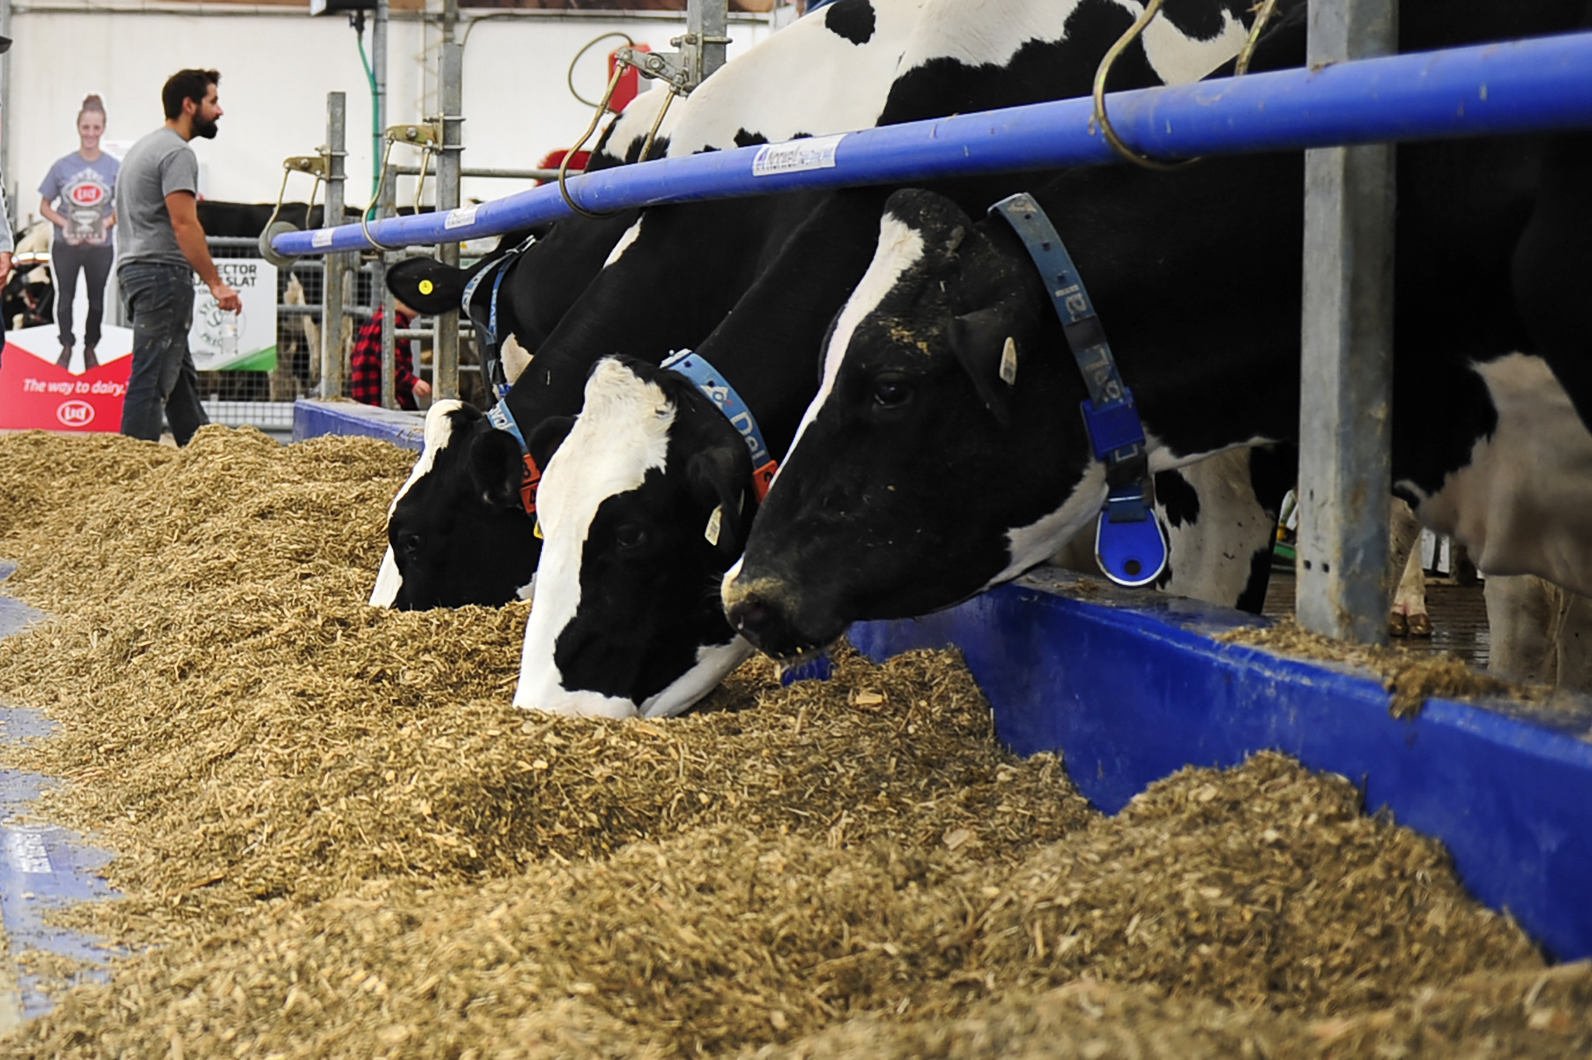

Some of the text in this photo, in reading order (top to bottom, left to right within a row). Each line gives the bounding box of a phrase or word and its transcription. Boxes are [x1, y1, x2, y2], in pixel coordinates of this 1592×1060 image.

[226, 276, 257, 287] SLAT
[23, 378, 46, 392] The
[48, 381, 75, 396] way
[75, 380, 90, 393] to
